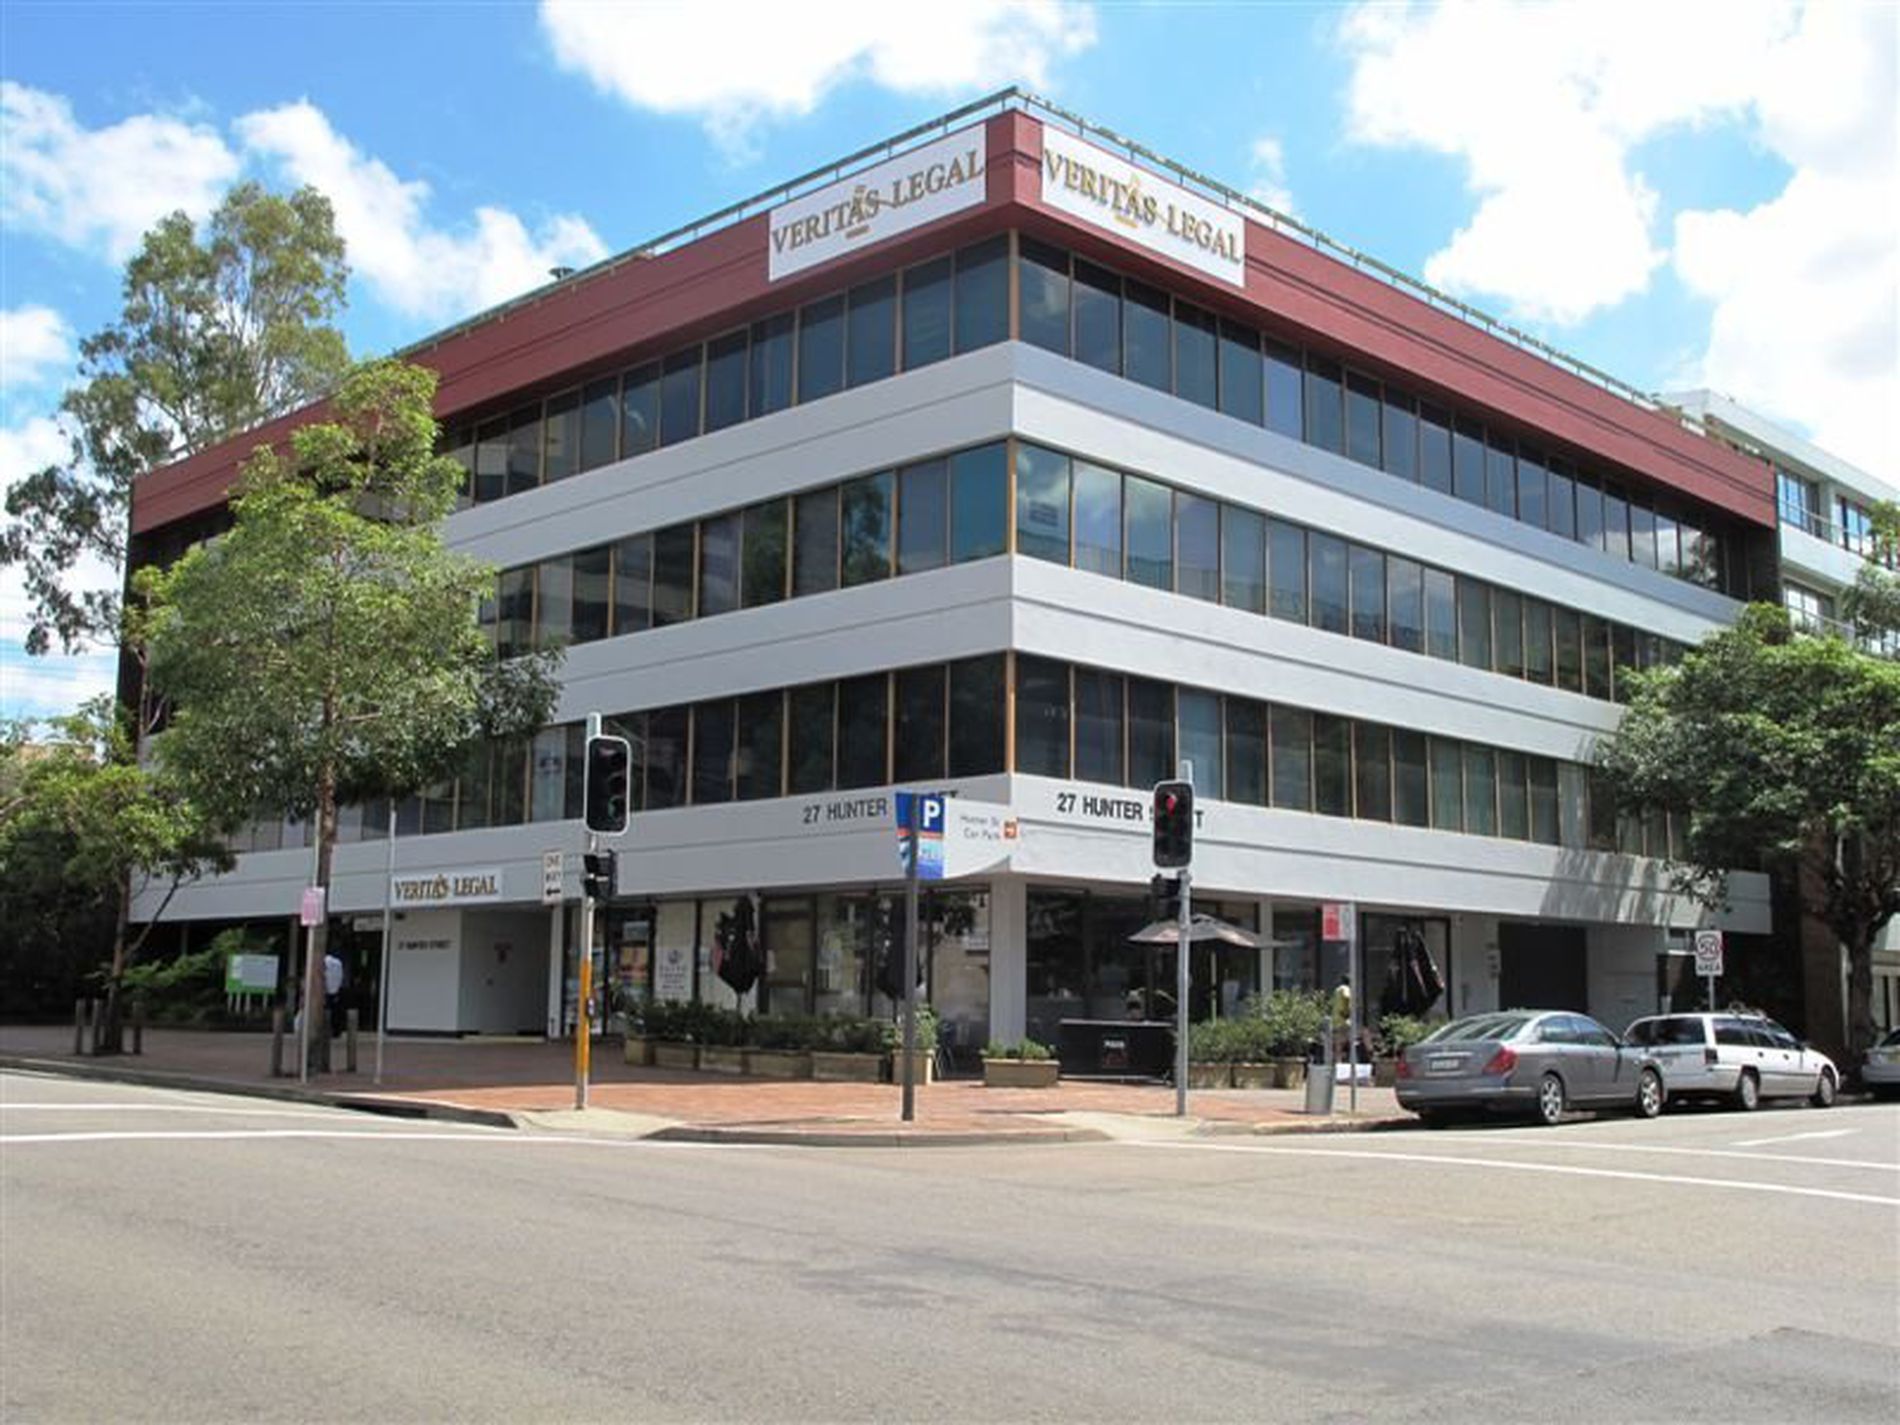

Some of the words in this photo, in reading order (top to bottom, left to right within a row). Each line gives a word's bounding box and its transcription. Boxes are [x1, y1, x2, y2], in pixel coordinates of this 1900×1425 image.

[772, 187, 880, 253] VERITAS
[891, 150, 984, 208] LEGAL
[1045, 149, 1157, 226] VERITAS
[1167, 204, 1241, 264] LEGAL
[803, 805, 821, 824] 27
[827, 798, 888, 820] HUNTER
[923, 800, 941, 828] P
[1057, 792, 1077, 813] 27
[1083, 796, 1144, 821] HUNTER
[454, 875, 499, 896] LEGAL
